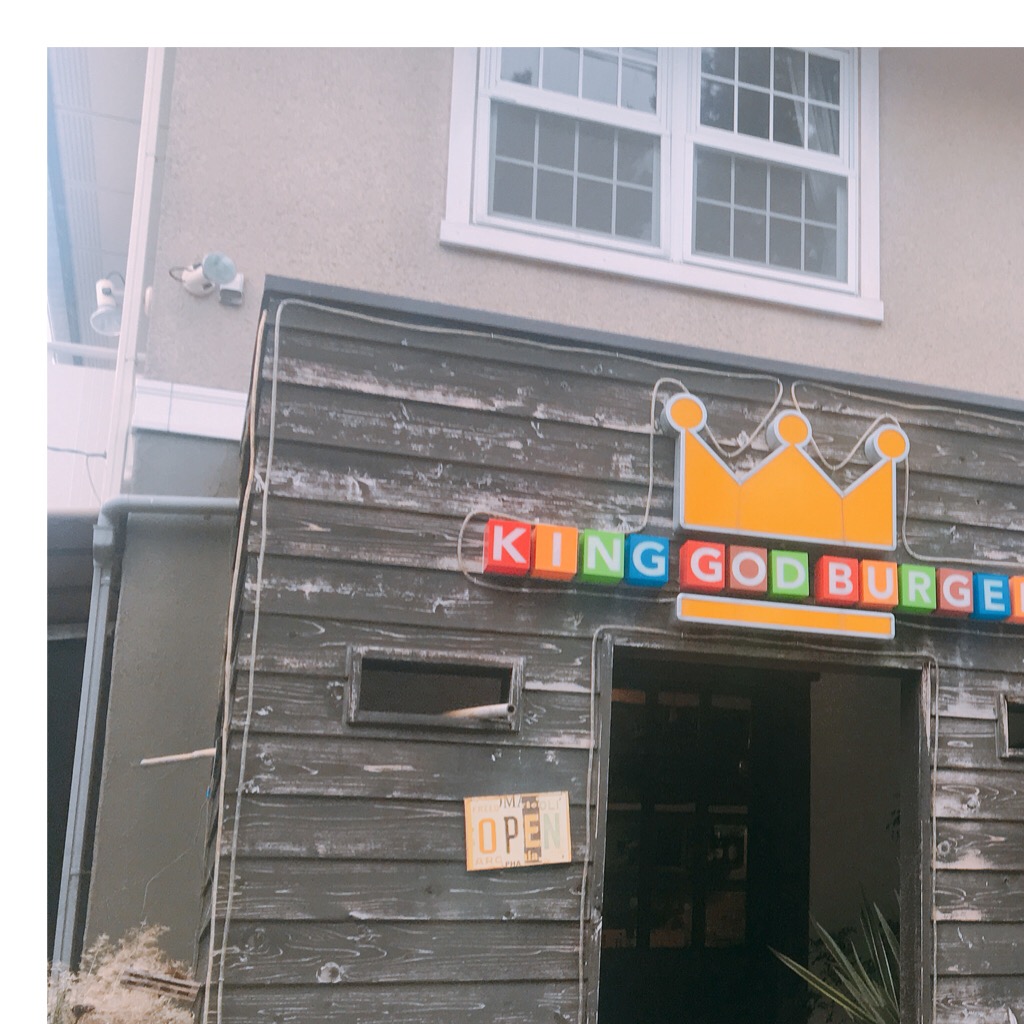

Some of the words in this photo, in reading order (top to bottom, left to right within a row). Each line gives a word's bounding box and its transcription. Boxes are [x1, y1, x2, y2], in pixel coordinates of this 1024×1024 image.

[492, 525, 665, 577] KING
[690, 547, 807, 589] GOD
[478, 812, 560, 855] OPEN
